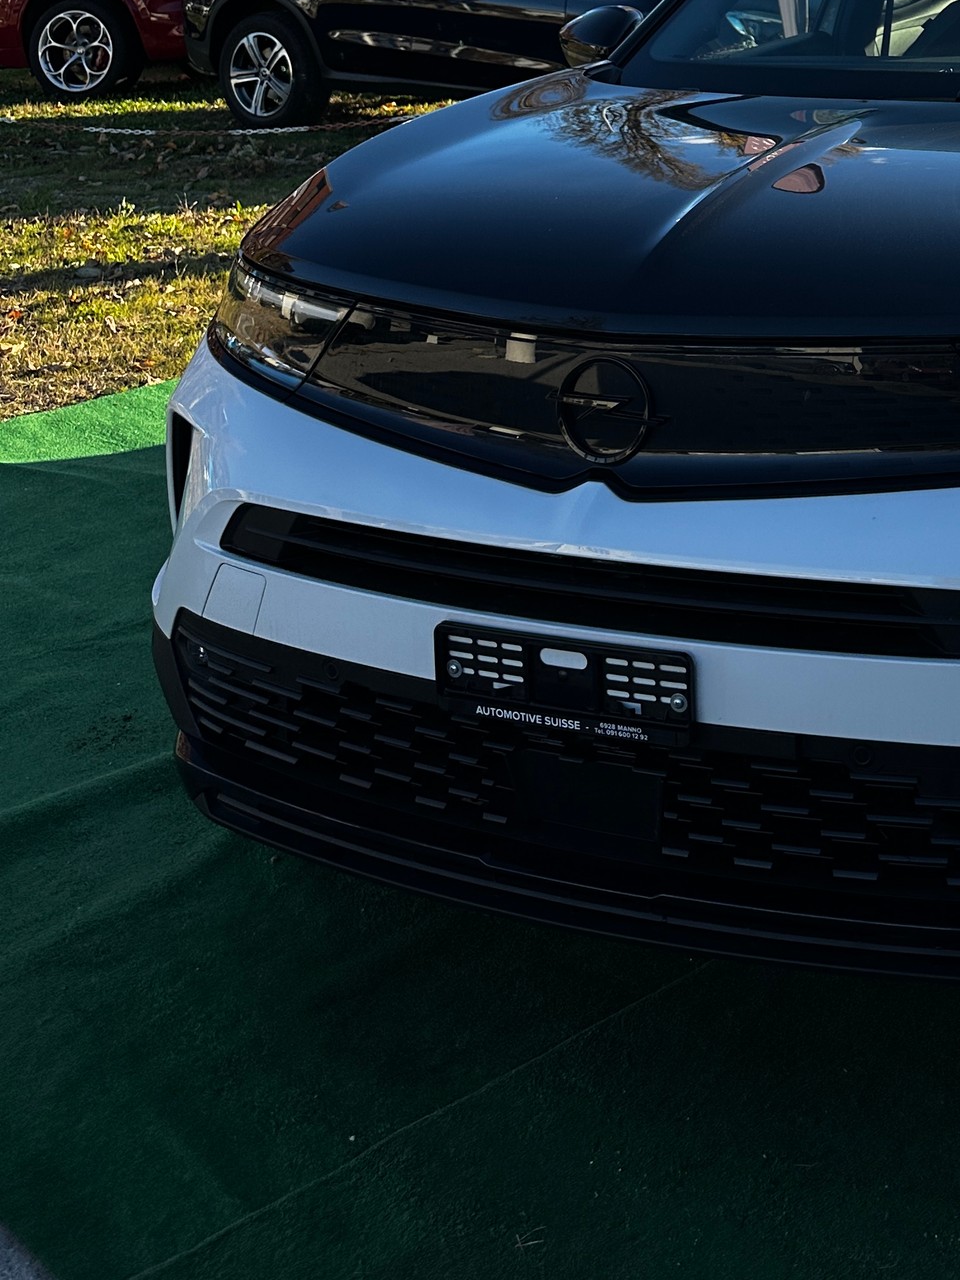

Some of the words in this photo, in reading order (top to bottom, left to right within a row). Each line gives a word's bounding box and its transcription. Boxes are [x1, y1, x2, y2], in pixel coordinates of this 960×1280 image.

[476, 705, 542, 725] AUTOMOTIVE
[544, 716, 581, 730] SUISSE
[599, 722, 616, 730] 6928
[617, 724, 642, 733] MANNO
